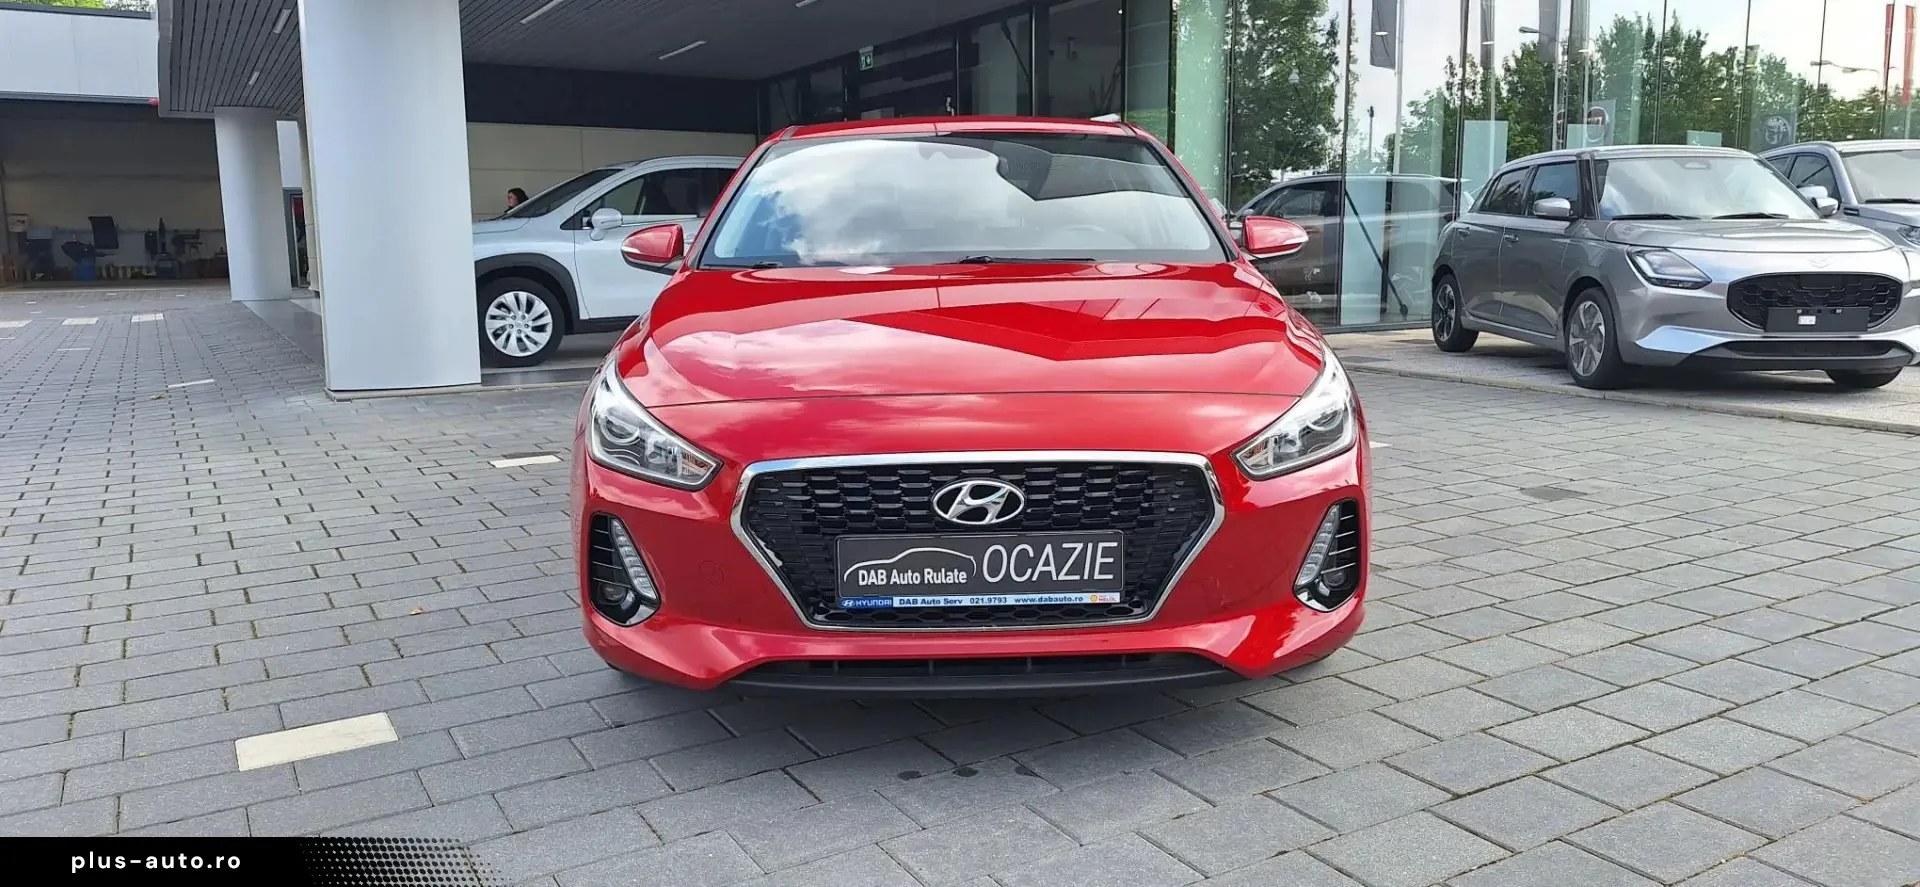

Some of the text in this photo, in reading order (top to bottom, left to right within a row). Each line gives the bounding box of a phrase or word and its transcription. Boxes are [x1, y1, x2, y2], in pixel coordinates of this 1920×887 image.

[982, 541, 1118, 583] OCAZIE
[858, 568, 967, 586] DAB Auto Rulate
[855, 599, 893, 607] HYUNDAI
[899, 598, 918, 606] DAB
[943, 597, 963, 605] Serv
[969, 596, 1008, 605] 021.9793
[1014, 595, 1084, 603] www.dabauto.ro
